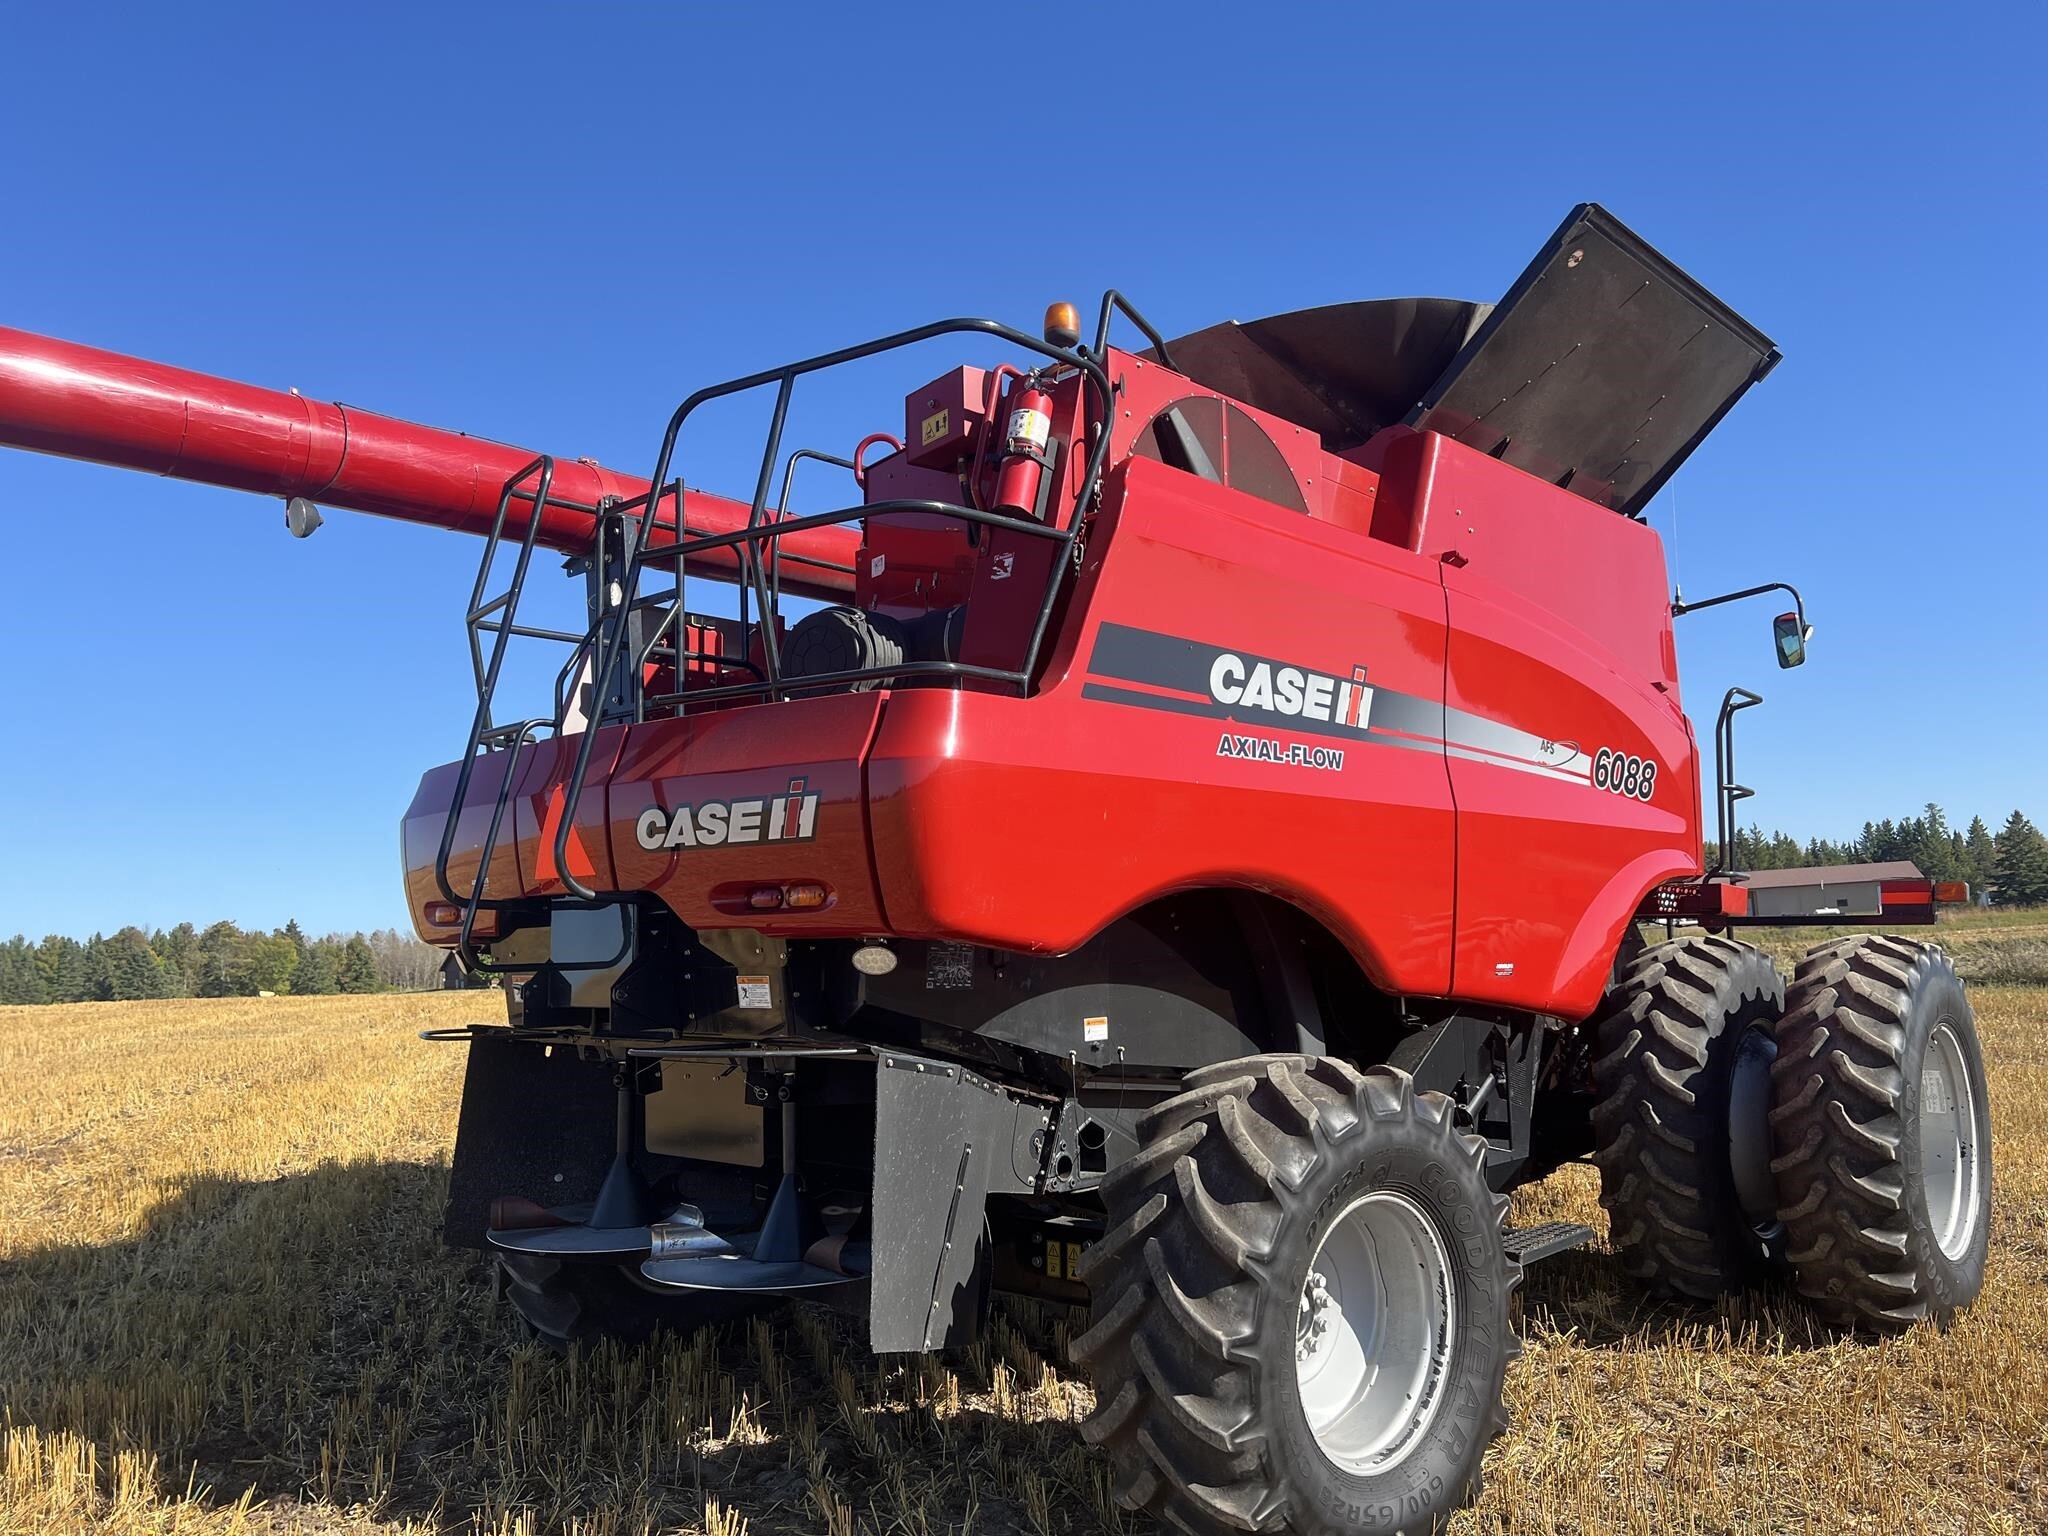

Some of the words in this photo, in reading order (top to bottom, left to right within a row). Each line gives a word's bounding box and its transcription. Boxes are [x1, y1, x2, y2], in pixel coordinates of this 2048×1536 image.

[1209, 653, 1335, 722] CASE
[1217, 733, 1344, 771] AXIAL-FLOW
[1540, 739, 1555, 755] AFS
[1593, 746, 1657, 802] 6088
[636, 800, 763, 850] CASE
[1420, 1160, 1494, 1467] GOODYEAR
[1318, 1474, 1445, 1528] 600/65R28
